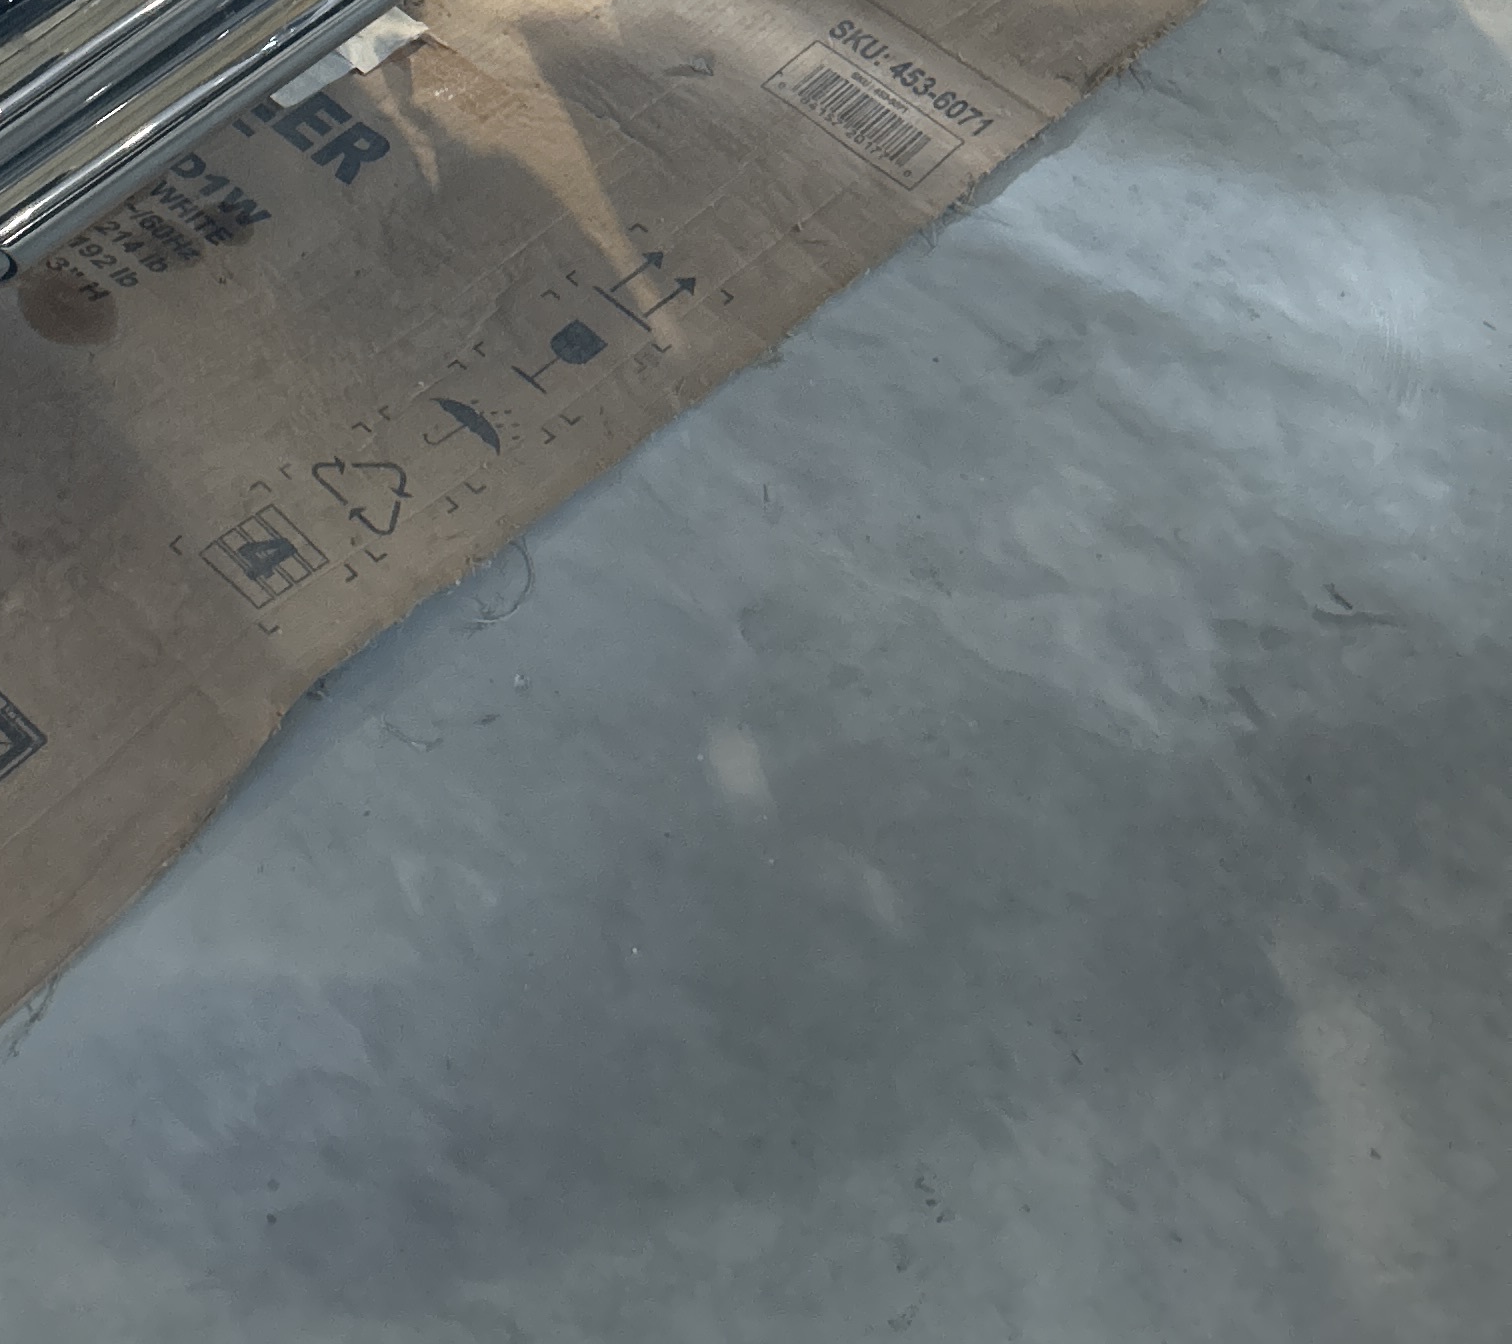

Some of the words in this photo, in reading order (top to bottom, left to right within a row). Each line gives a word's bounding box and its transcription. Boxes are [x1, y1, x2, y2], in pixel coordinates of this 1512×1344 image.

[829, 19, 890, 66] SKU:
[890, 62, 994, 137] 453-6071
[94, 220, 145, 253] 214
[150, 179, 234, 247] WHITE
[68, 234, 118, 269] 192
